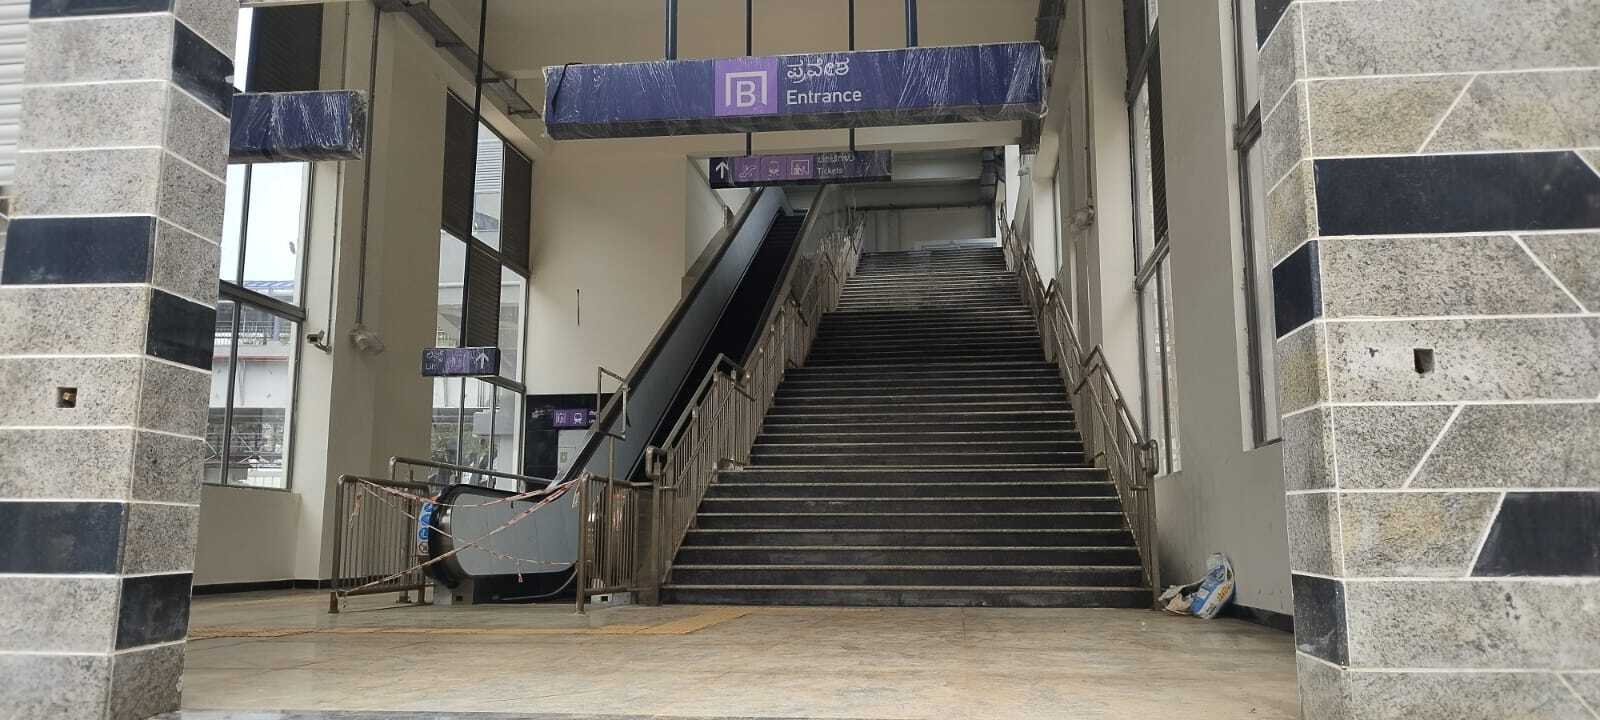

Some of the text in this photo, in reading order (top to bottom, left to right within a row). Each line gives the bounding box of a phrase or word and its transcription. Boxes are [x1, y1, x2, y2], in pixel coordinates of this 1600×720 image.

[786, 57, 850, 84] ಪ್ರವೇಶ
[736, 80, 756, 108] B
[786, 89, 862, 105] Entrance
